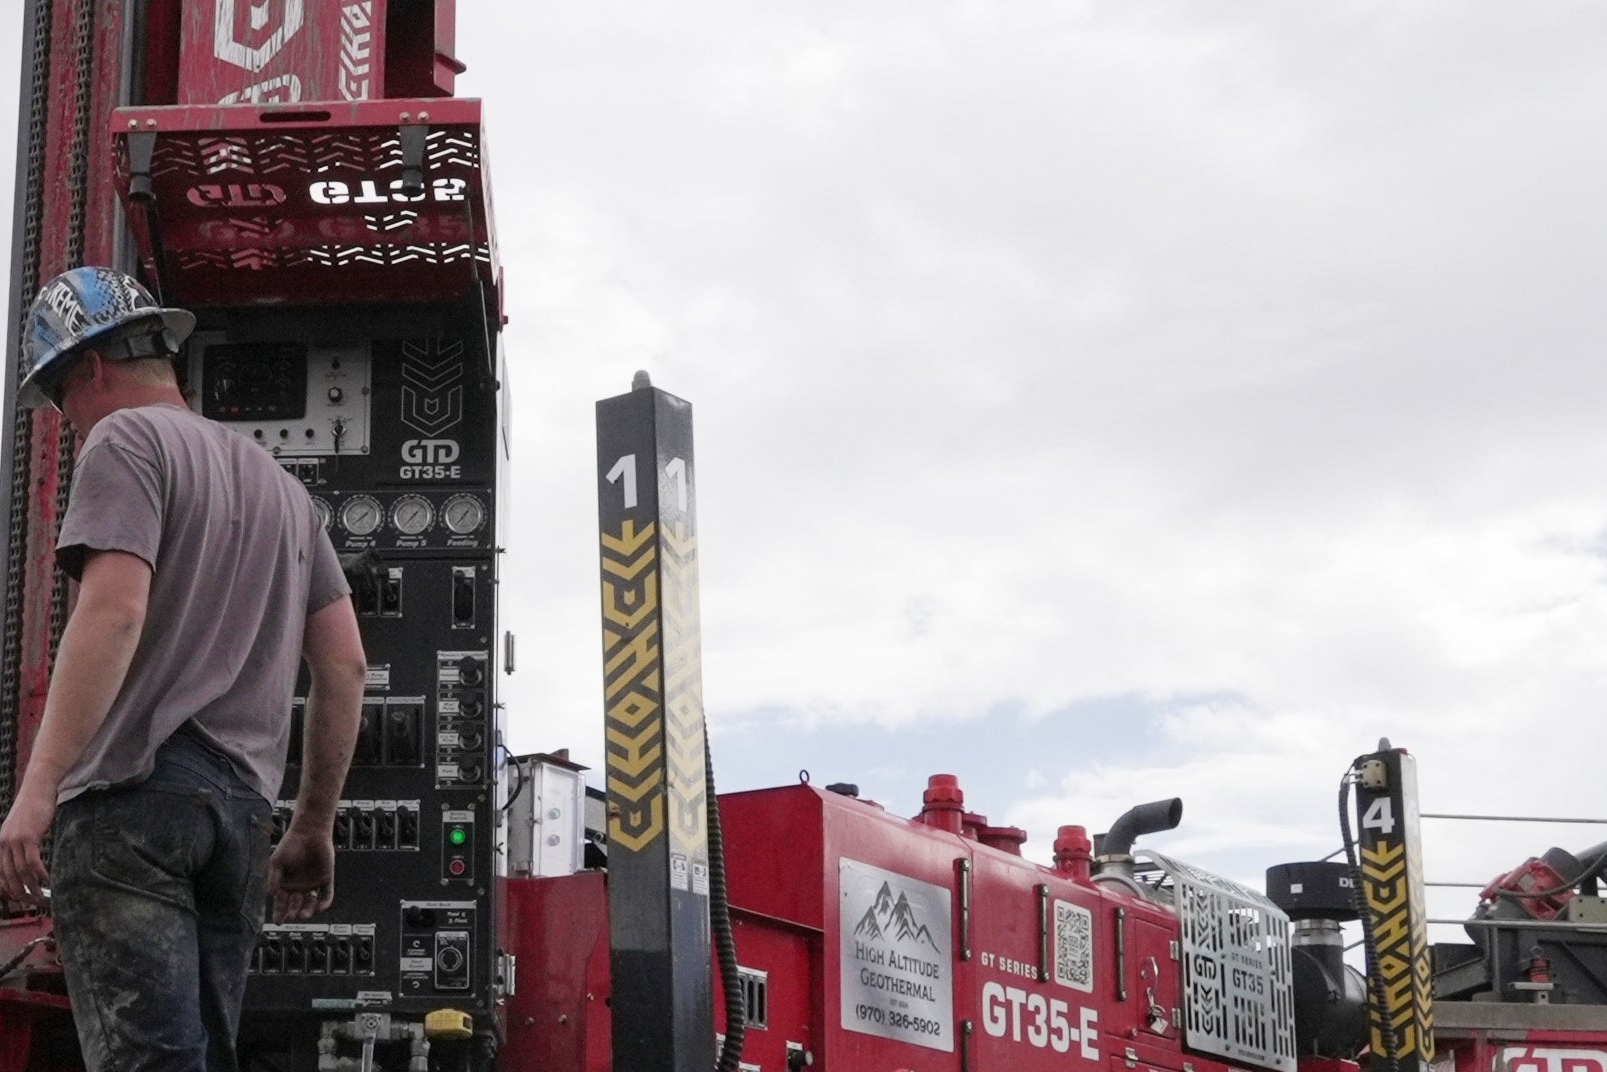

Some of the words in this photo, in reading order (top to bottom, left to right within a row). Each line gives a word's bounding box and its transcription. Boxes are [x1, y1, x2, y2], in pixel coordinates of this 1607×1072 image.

[401, 440, 460, 464] GTD
[400, 465, 461, 479] GT35-E
[606, 454, 638, 508] 1
[1362, 797, 1395, 834] 4
[981, 952, 995, 967] GT
[999, 957, 1038, 980] SERIES
[1194, 954, 1217, 980] GTD
[1232, 968, 1264, 995] GT35
[856, 1004, 886, 1024] (970)
[888, 1011, 941, 1036] 326-5902
[982, 981, 1100, 1061] GT35-E
